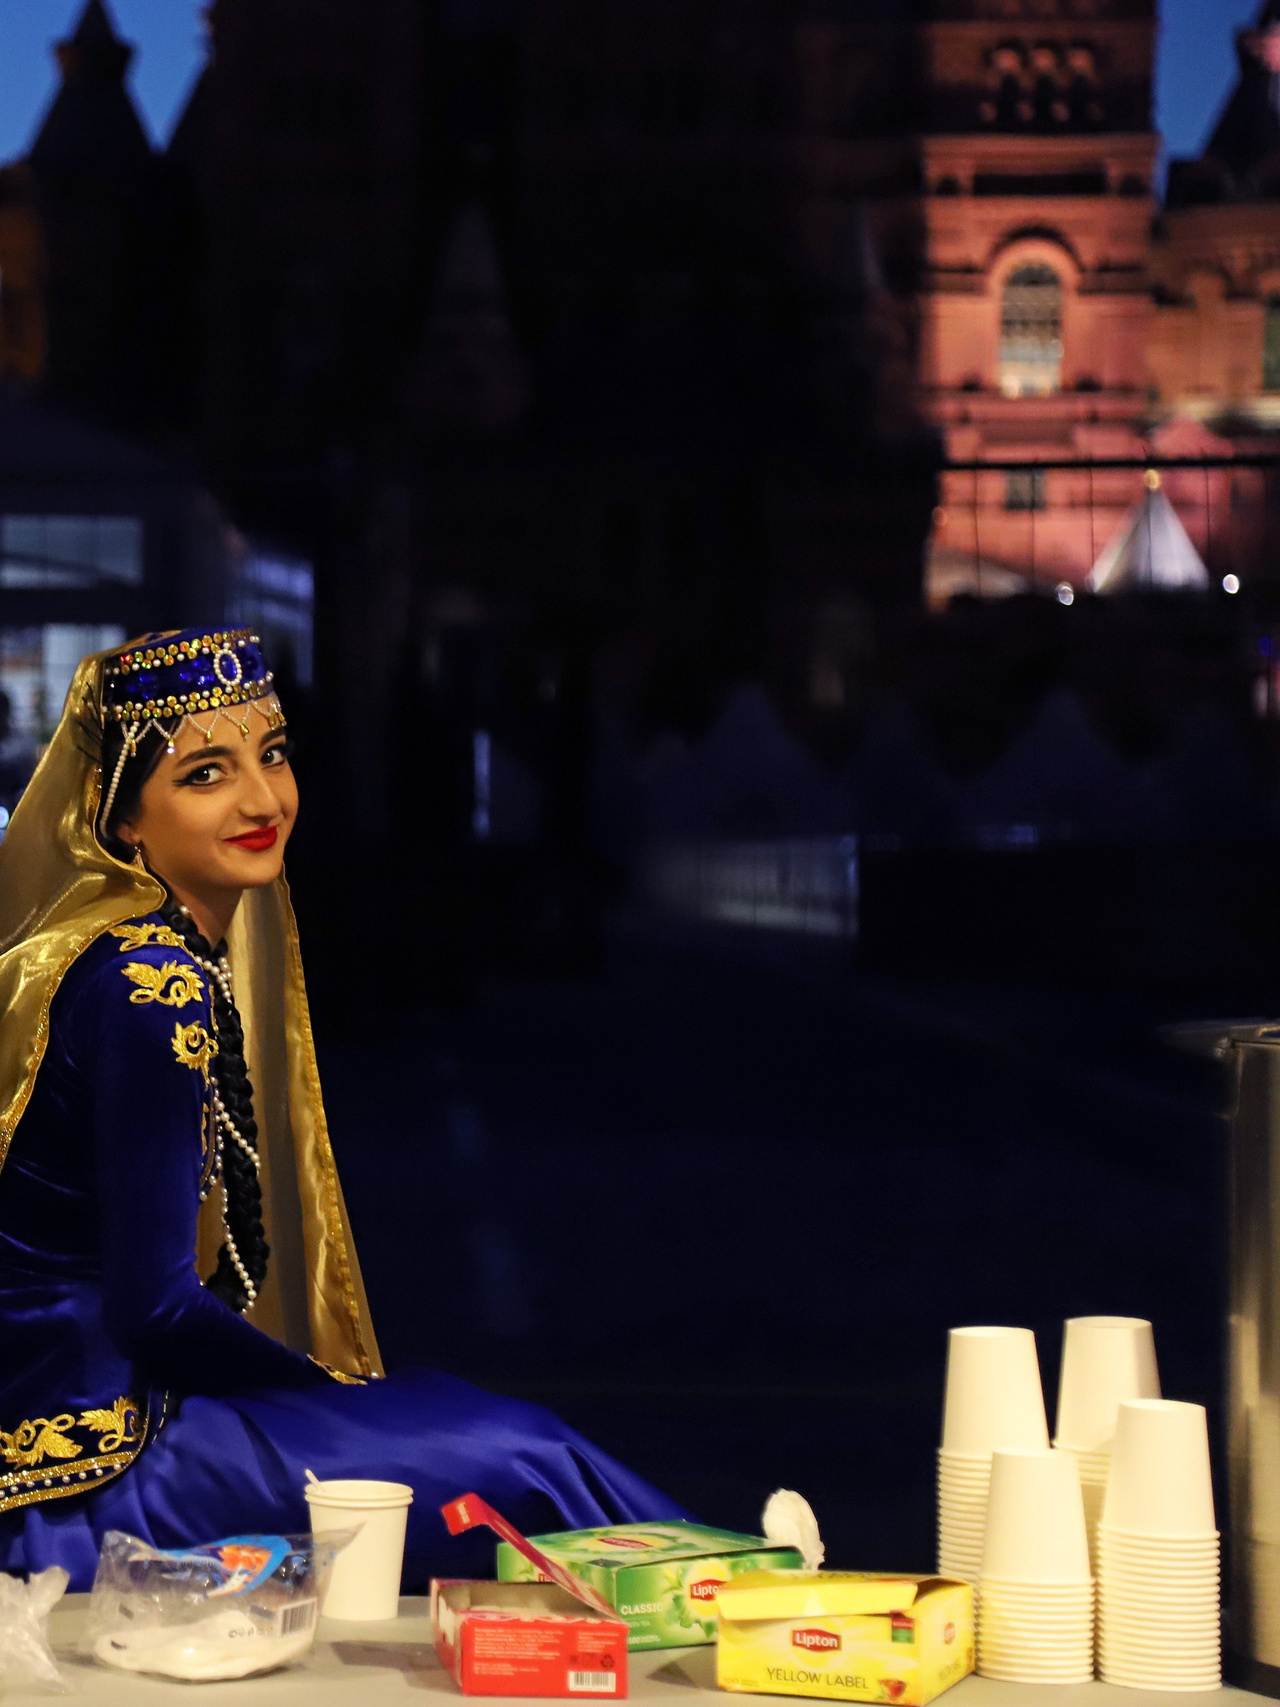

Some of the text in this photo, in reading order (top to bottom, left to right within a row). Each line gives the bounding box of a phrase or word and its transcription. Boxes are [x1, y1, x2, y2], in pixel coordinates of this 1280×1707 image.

[692, 1584, 720, 1598] Lipto
[621, 1603, 663, 1615] CLASSIC
[795, 1632, 838, 1648] Lipton
[767, 1667, 822, 1684] YELLOW
[827, 1674, 870, 1689] LABEL
